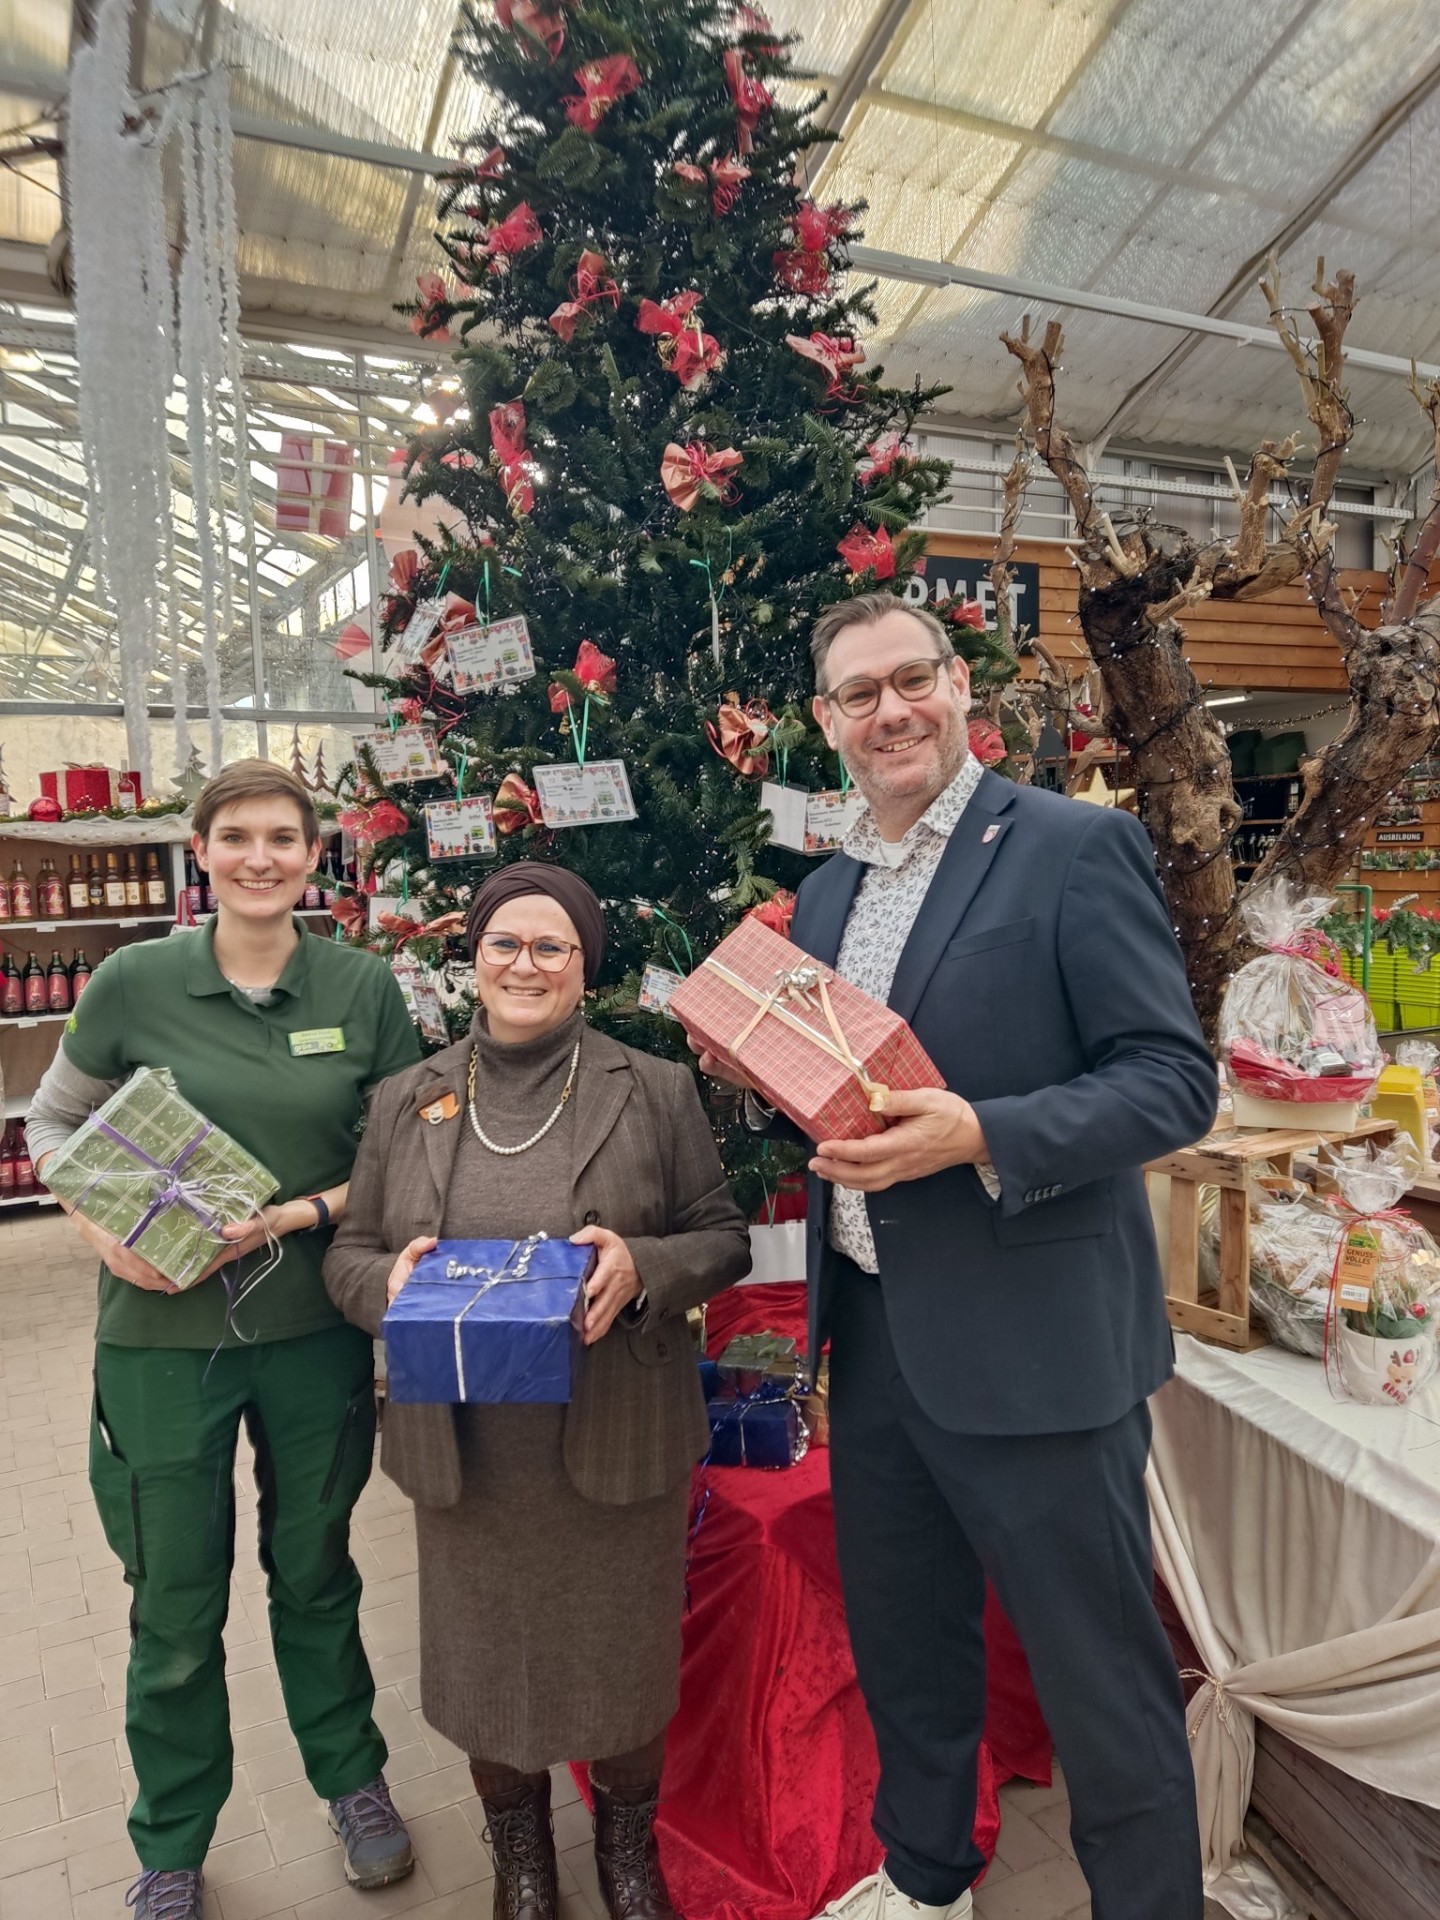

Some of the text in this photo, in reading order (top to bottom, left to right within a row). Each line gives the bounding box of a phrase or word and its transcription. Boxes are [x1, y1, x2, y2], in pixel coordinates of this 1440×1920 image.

[1378, 833, 1421, 841] AUSBILDUNG
[1346, 1248, 1377, 1259] GENUSS-
[1345, 1255, 1371, 1265] VOLLES
